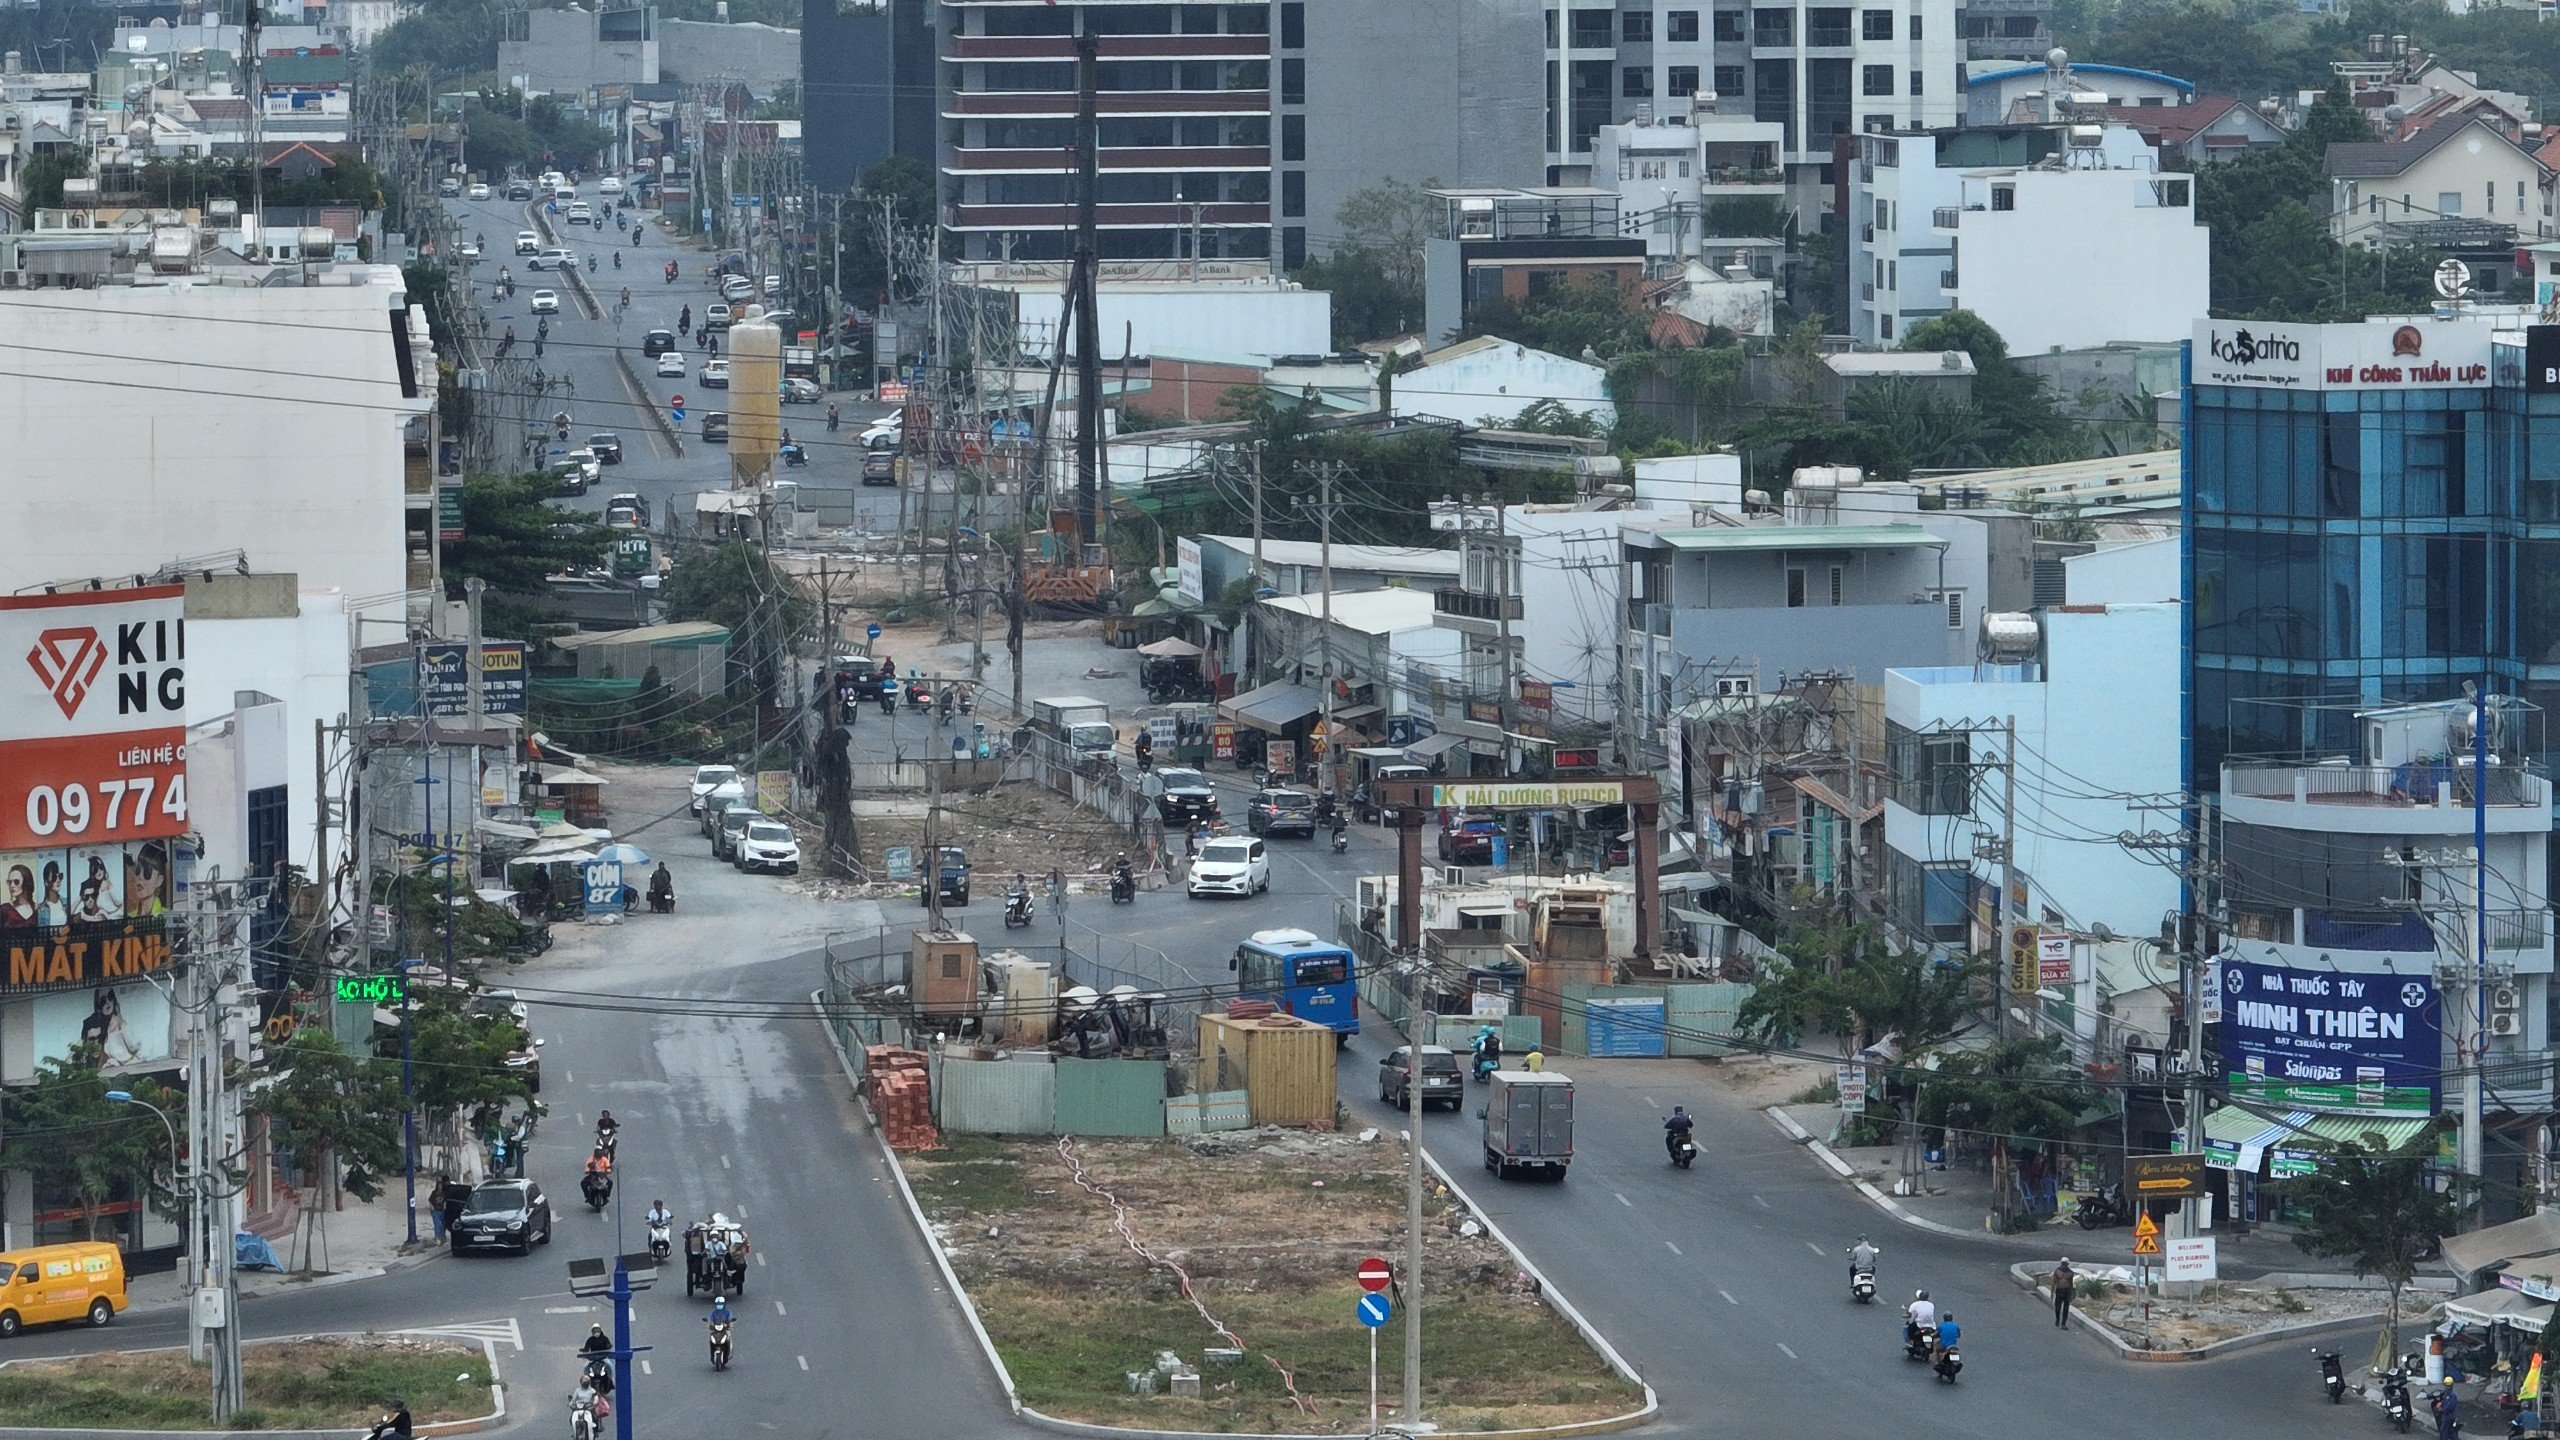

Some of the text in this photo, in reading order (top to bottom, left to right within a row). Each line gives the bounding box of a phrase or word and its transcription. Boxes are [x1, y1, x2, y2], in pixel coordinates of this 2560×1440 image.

[2326, 364, 2354, 383] KHÍ
[2359, 364, 2403, 383] CÔNG
[2457, 363, 2487, 384] LỰC
[118, 667, 184, 715] NG
[118, 746, 151, 767] LIÊN
[153, 742, 174, 765] HỆ
[588, 887, 619, 903] 87
[10, 924, 88, 986] MẮT
[2011, 949, 2024, 990] Coffee
[2262, 973, 2366, 998] NHÀ THUỐC TÂY
[2237, 1000, 2404, 1039] MINH THIÊN
[2329, 1042, 2353, 1051] GPP
[2284, 1059, 2343, 1081] Salonpas
